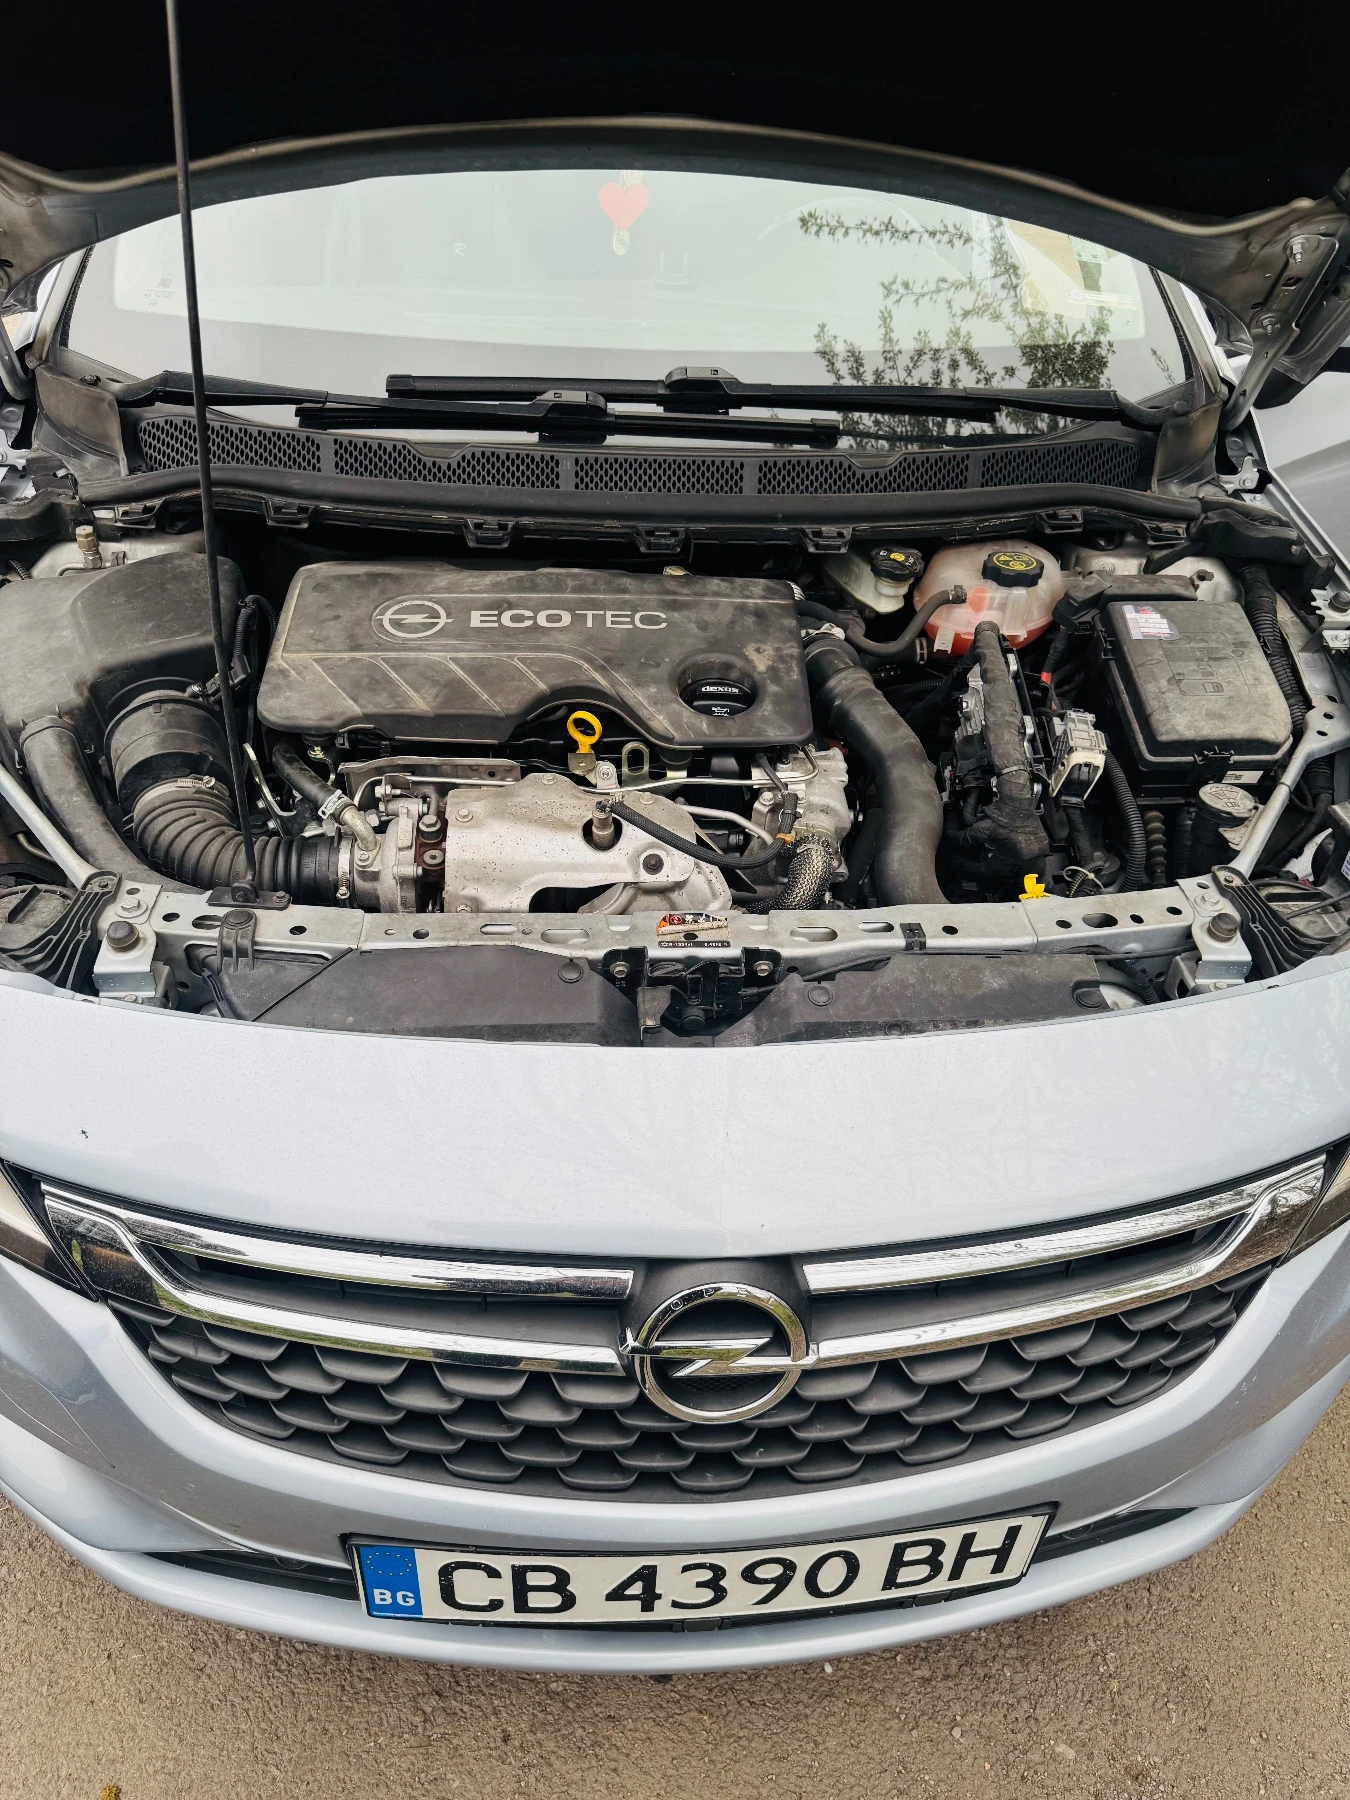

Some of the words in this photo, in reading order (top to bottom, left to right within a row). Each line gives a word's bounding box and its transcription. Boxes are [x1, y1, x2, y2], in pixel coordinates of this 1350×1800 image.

[470, 609, 668, 630] ECOTEC
[438, 1561, 577, 1614] CB
[604, 1550, 861, 1613] 4390
[881, 1525, 1023, 1592] BH
[373, 1588, 416, 1607] BG
